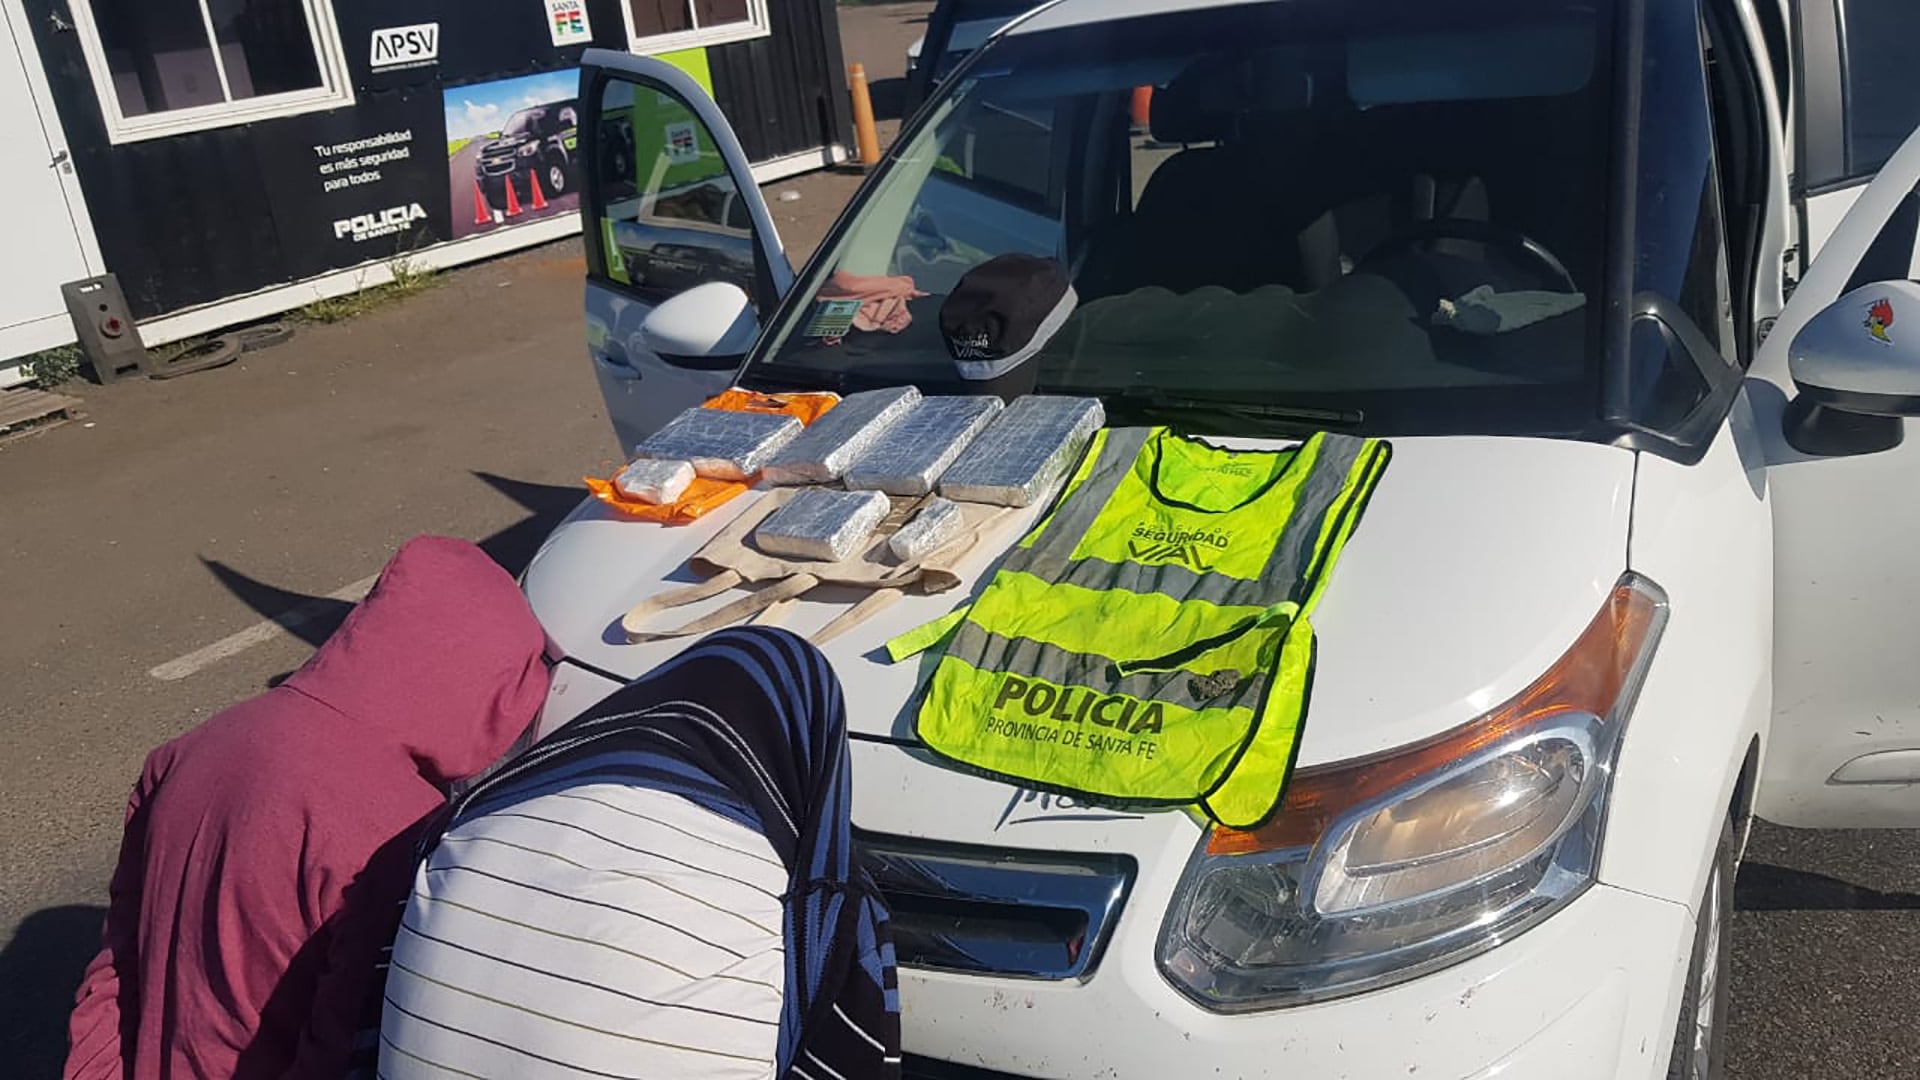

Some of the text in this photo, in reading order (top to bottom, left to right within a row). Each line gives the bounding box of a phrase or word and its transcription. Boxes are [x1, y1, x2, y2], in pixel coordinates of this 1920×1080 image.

[551, 0, 580, 11] SANTA
[554, 10, 584, 36] FE
[375, 28, 433, 60] APSV
[314, 129, 412, 157] Tu responsabilidad
[319, 163, 334, 174] es
[358, 146, 410, 166] seguridad
[323, 170, 381, 193] para todos
[333, 202, 428, 239] POLICIA
[353, 221, 411, 242] DE SANTA FE
[1132, 527, 1228, 548] SEGURIDAD
[1127, 540, 1214, 570] VIAL
[993, 675, 1164, 735] POLICIA
[985, 716, 1157, 760] PROVINCIA DE SANTA FE
